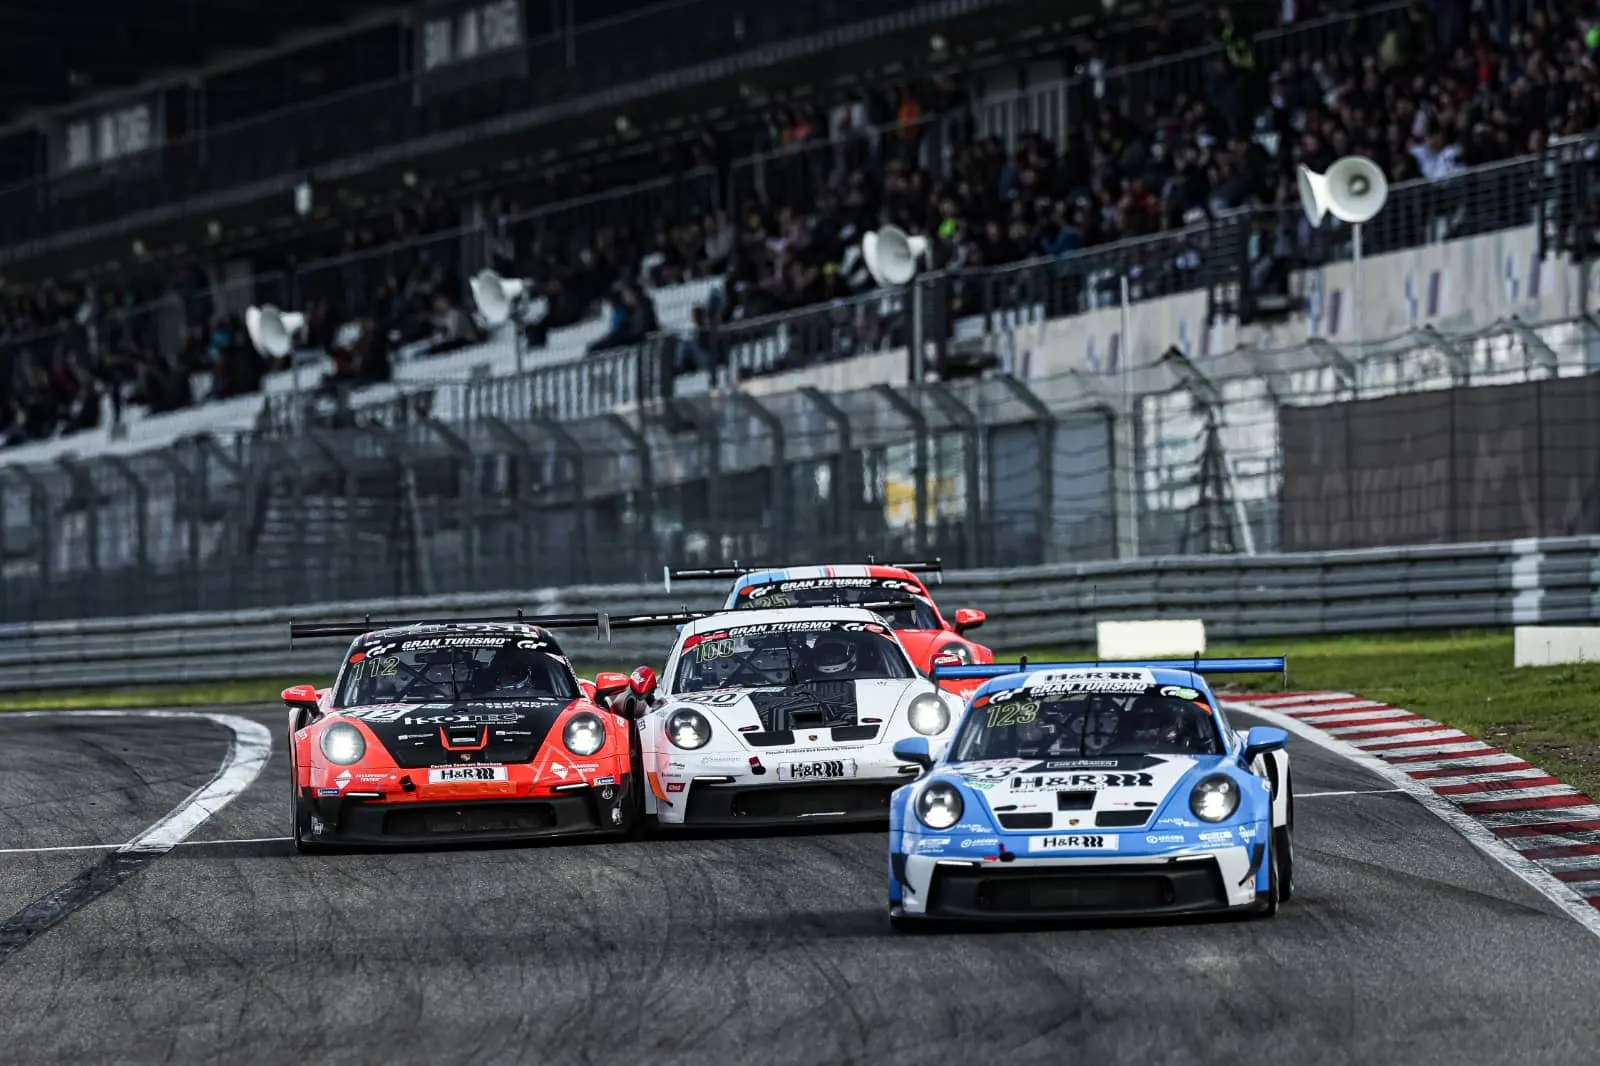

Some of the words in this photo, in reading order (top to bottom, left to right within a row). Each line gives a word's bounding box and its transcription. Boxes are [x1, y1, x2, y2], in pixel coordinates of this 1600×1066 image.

[781, 581, 815, 591] GRAN
[729, 624, 767, 635] GRAN
[771, 621, 832, 630] TURISMO
[401, 638, 441, 649] GRAN
[445, 637, 506, 646] TURISMO
[696, 638, 735, 663] 100
[353, 655, 400, 681] 112
[1030, 683, 1073, 695] GRAN
[1079, 682, 1147, 693] TURISMO
[987, 703, 1039, 728] 123
[441, 769, 473, 780] H&R
[791, 762, 822, 777] H&R
[1010, 774, 1098, 788] H&R
[1043, 836, 1080, 848] H&R
